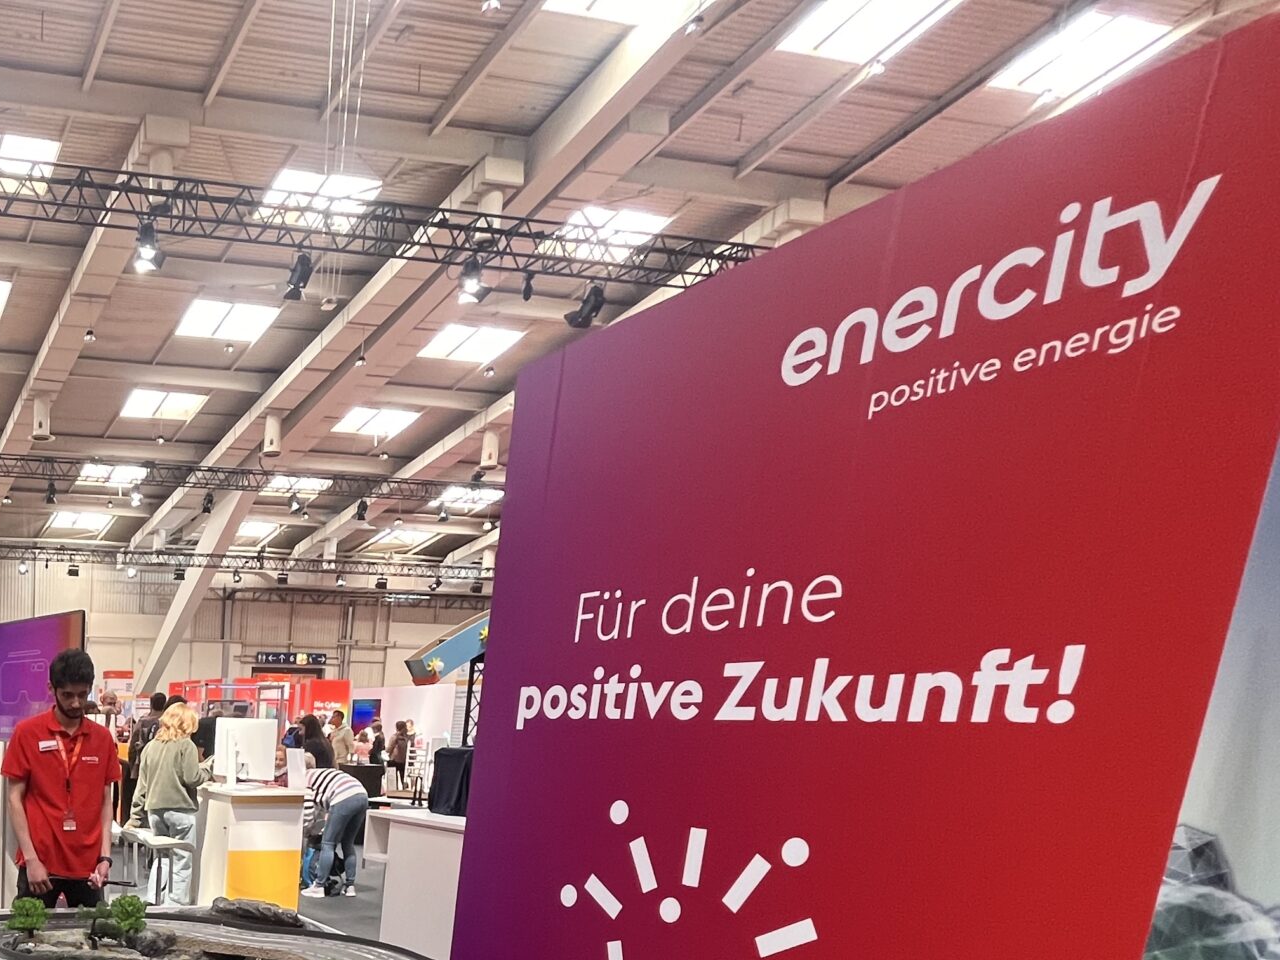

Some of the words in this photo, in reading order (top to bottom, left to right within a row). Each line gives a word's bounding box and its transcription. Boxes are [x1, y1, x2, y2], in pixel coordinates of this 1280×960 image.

[779, 173, 1224, 388] enercity
[866, 356, 1003, 421] positive
[1011, 301, 1183, 374] energie
[574, 589, 646, 646] Für
[661, 567, 843, 639] deine
[516, 664, 703, 731] positive
[715, 643, 1087, 727] Zukunft!
